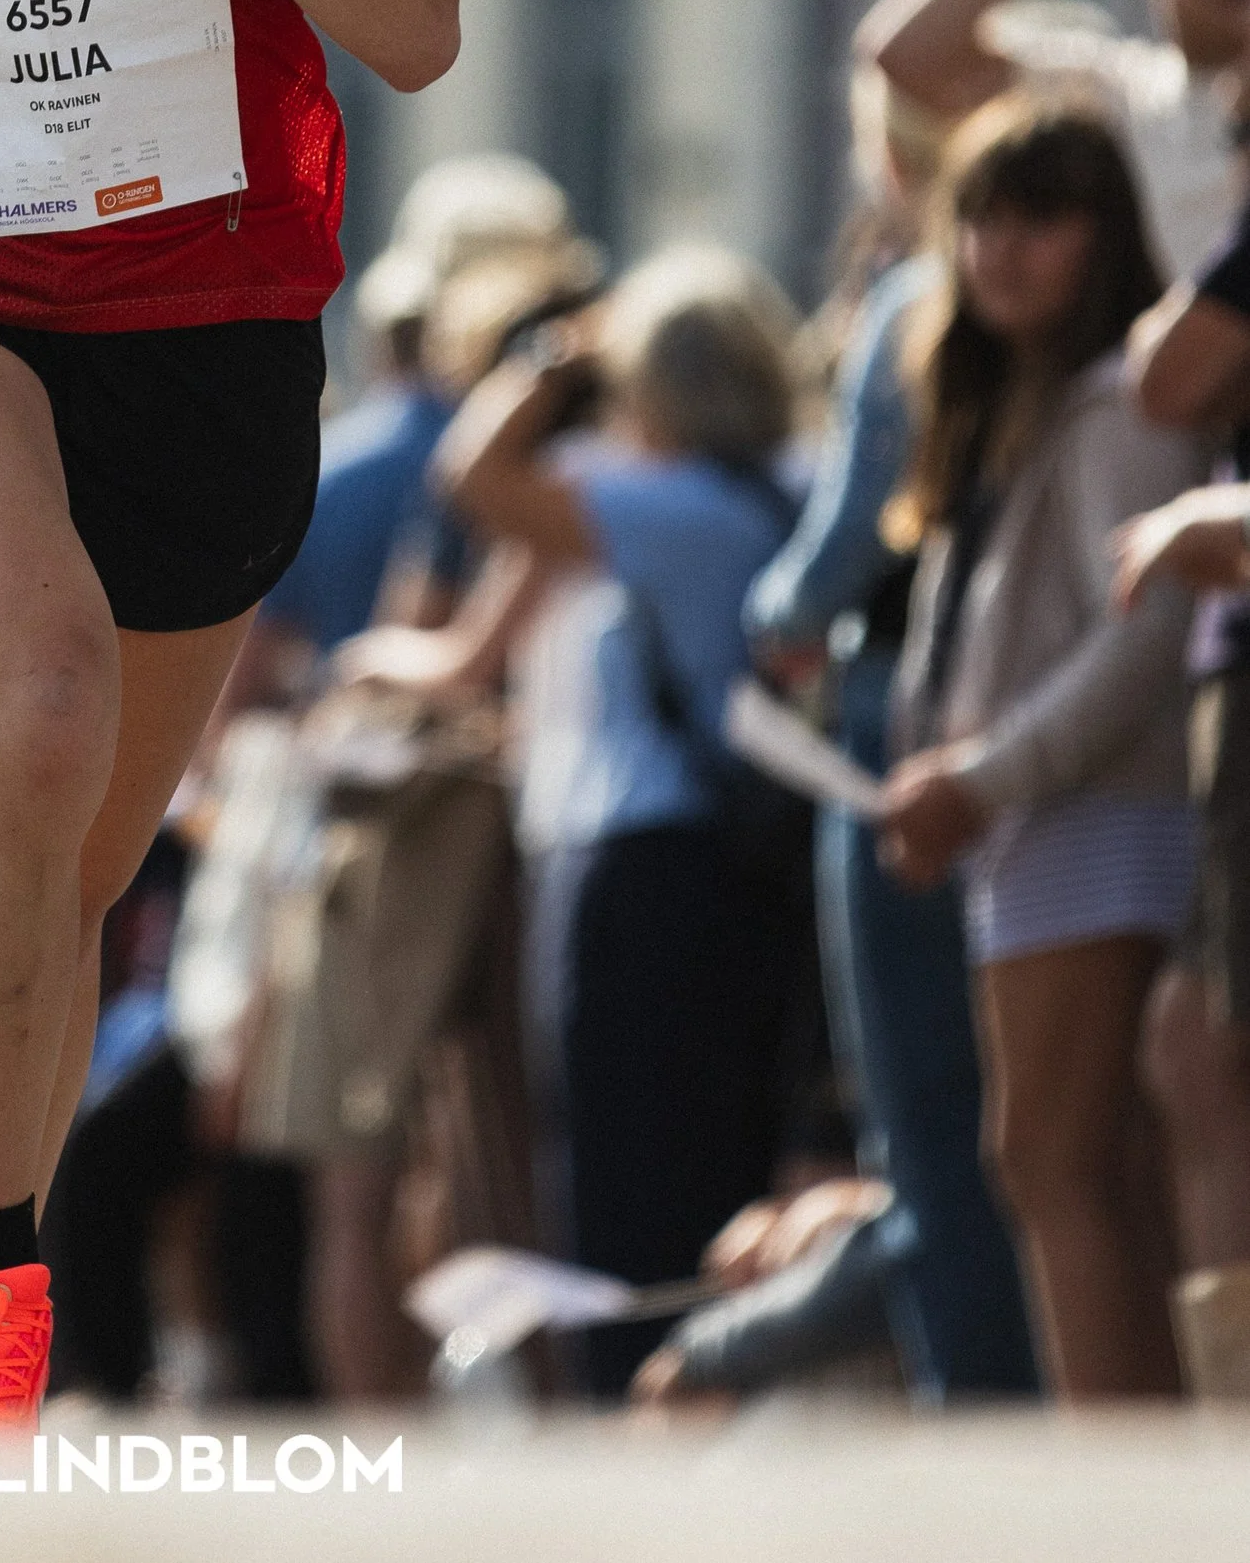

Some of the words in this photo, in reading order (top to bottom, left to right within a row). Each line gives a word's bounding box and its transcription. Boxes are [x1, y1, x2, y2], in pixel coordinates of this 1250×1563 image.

[10, 43, 112, 84] JULIA
[29, 100, 46, 112] OK
[48, 92, 101, 111] RAVINEN
[44, 123, 64, 134] D18
[67, 118, 91, 132] ELIT
